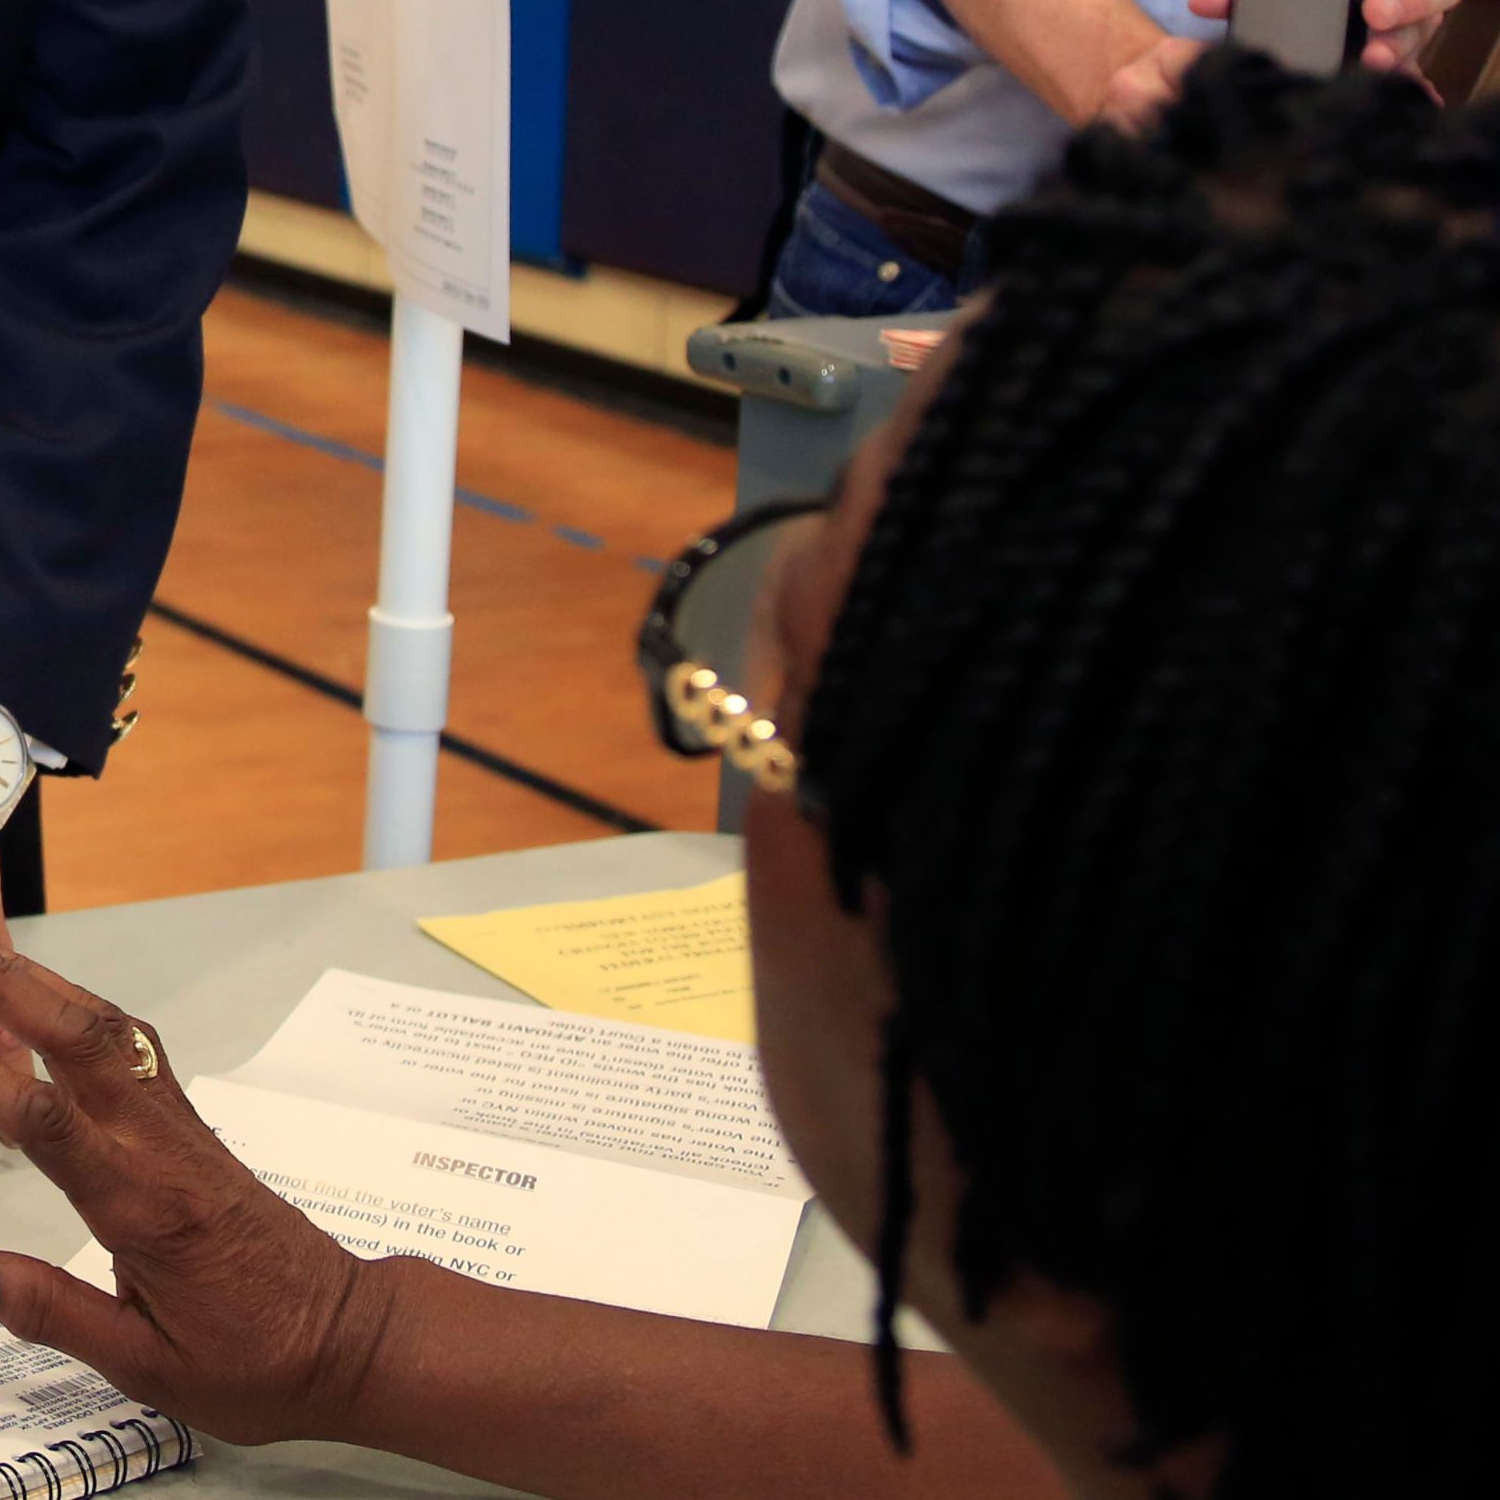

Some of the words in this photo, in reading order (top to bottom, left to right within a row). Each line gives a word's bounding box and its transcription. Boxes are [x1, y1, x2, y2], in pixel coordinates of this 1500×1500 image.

[412, 1151, 538, 1192] INSPECTOR
[293, 1196, 389, 1227] variations)
[393, 1218, 410, 1231] in
[416, 1222, 448, 1241] the
[452, 1230, 498, 1252] book
[505, 1244, 526, 1257] or
[314, 1180, 350, 1201] find
[354, 1189, 385, 1207] the
[390, 1199, 453, 1223] voter's
[457, 1213, 512, 1236] name
[449, 1257, 491, 1277] NYC
[495, 1269, 517, 1282] or
[43, 1410, 94, 1430] DOLORES
